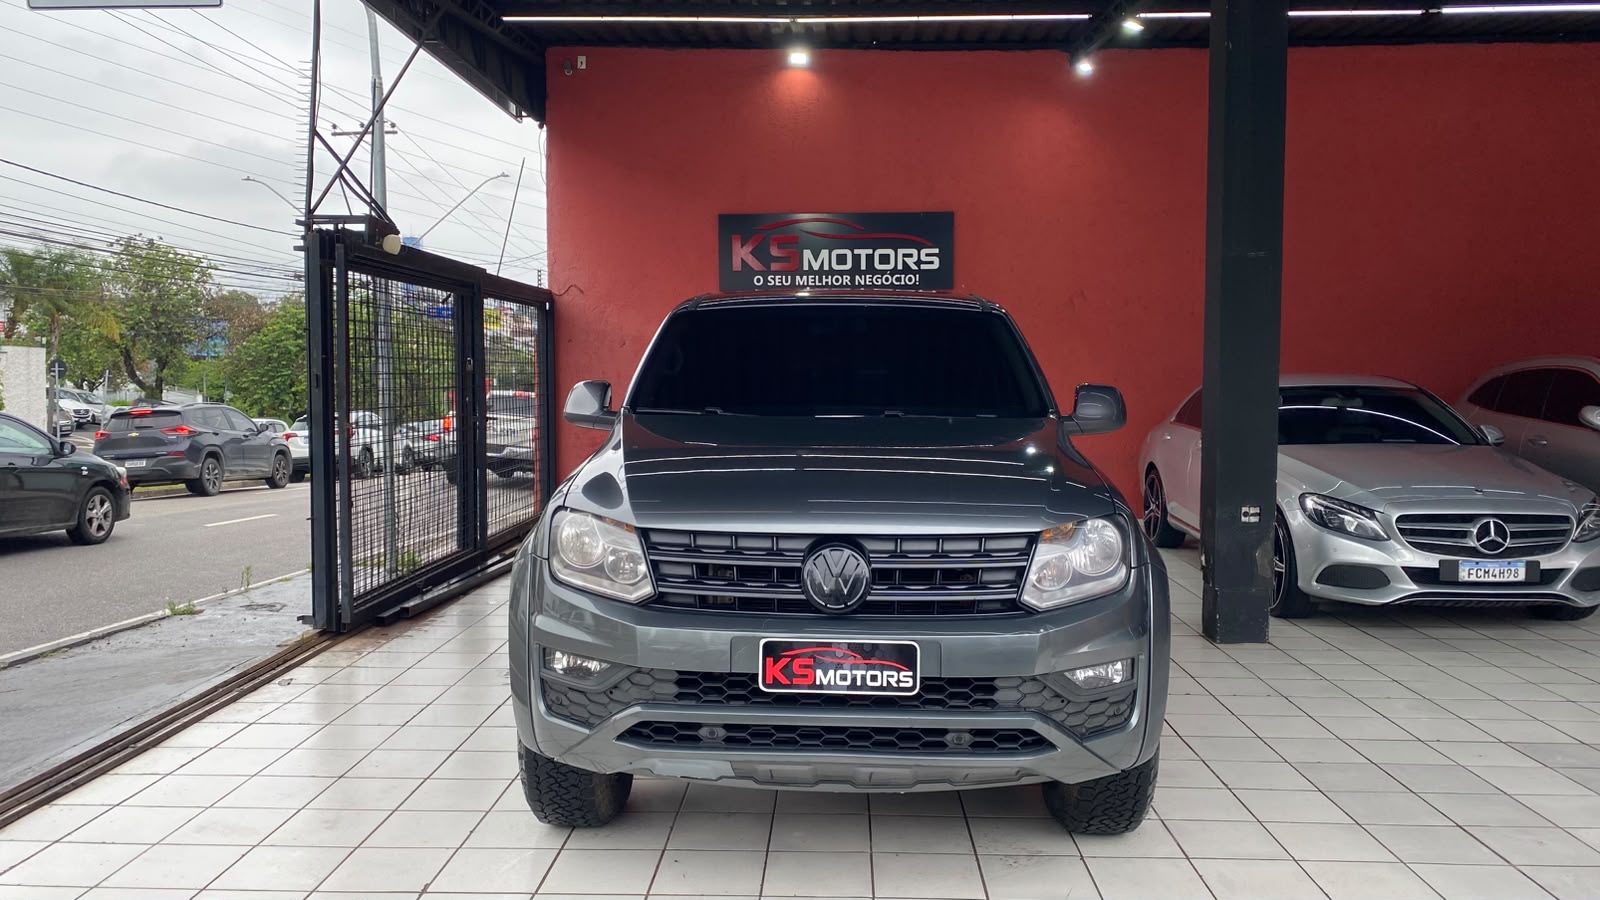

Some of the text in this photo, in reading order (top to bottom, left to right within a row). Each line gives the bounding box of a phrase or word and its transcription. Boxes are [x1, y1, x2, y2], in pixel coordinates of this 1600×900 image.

[803, 247, 940, 271] MOTORS
[753, 271, 920, 286] O SEU MELHOR NEGÓCIO!
[808, 548, 864, 596] VW
[1467, 567, 1520, 580] FCM4H98
[815, 669, 914, 688] MOTORS
